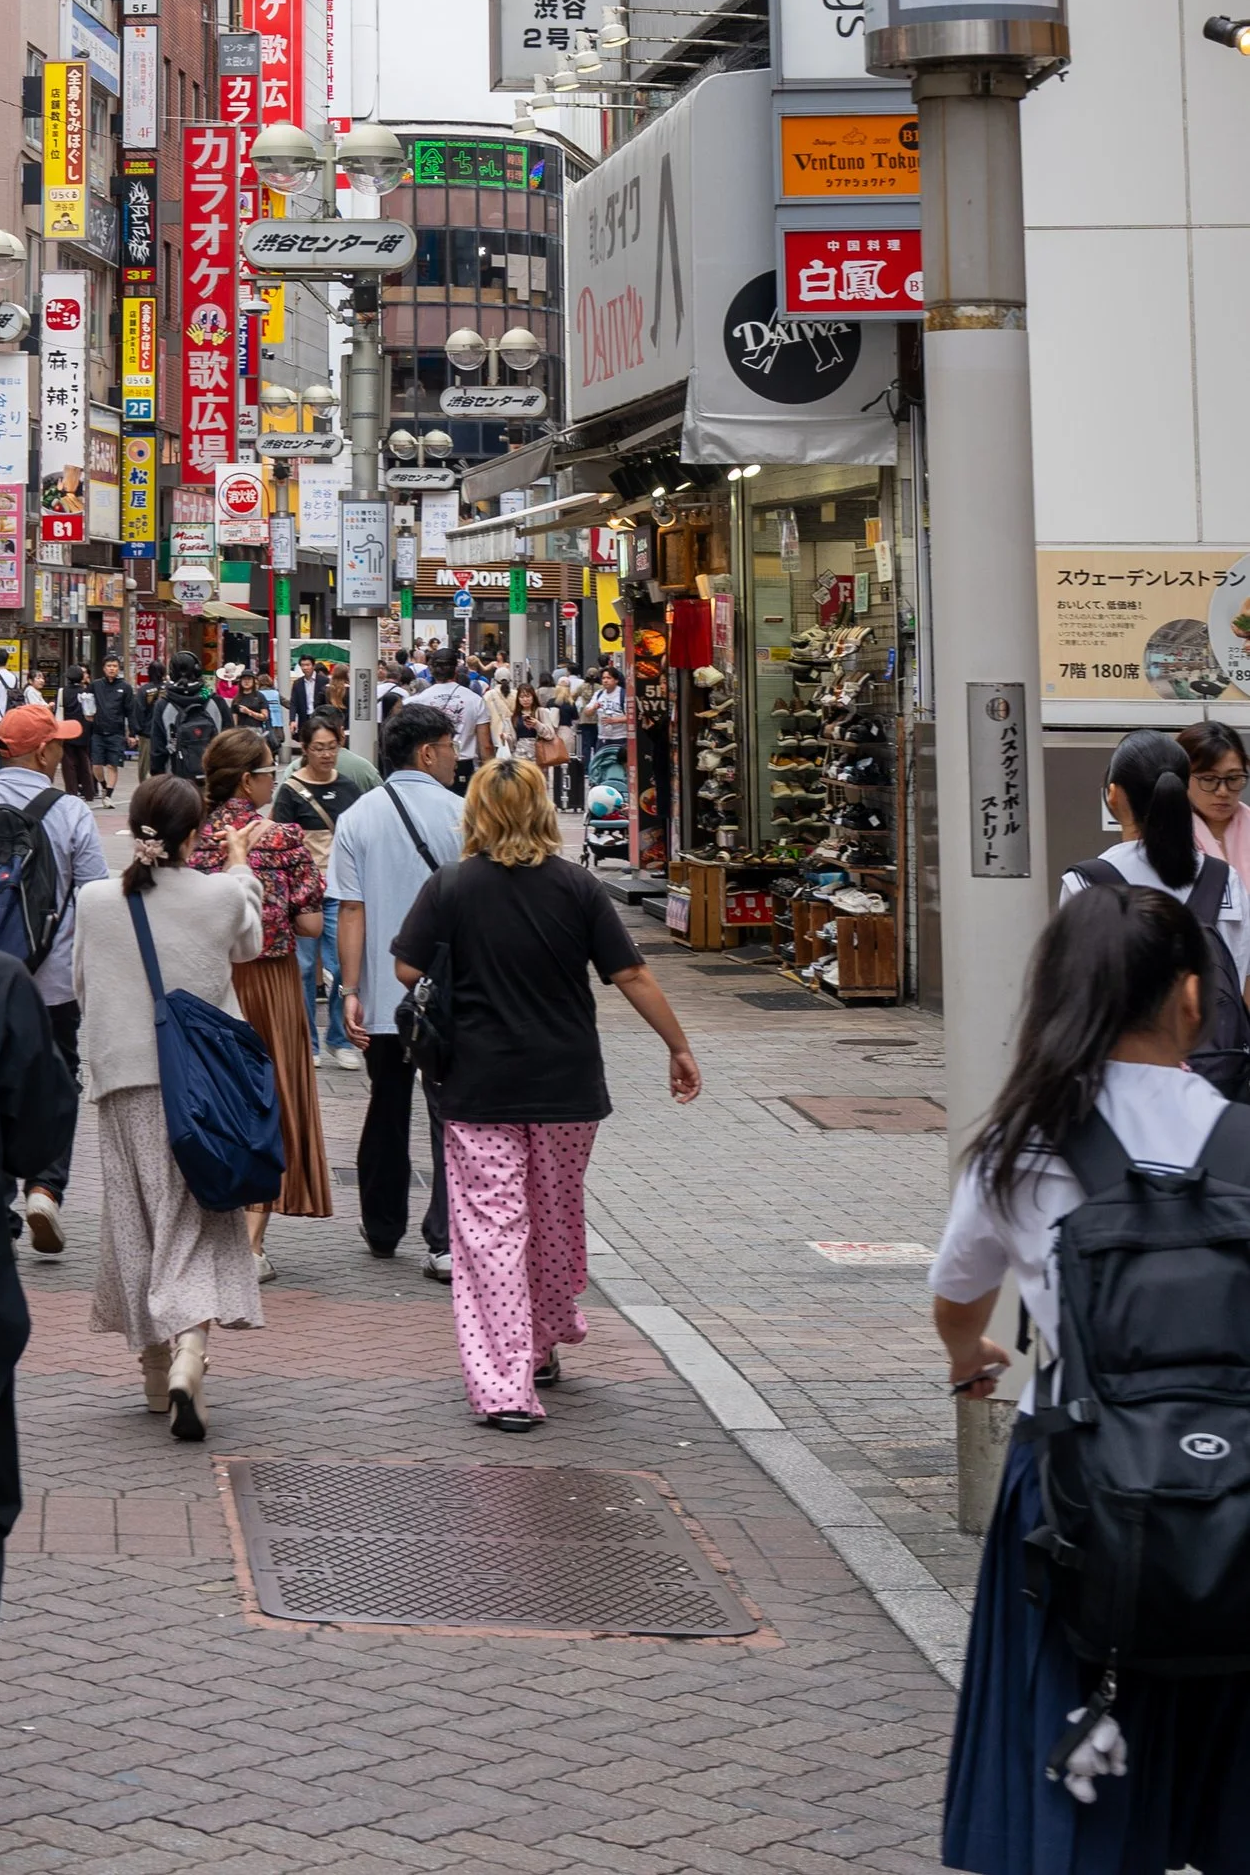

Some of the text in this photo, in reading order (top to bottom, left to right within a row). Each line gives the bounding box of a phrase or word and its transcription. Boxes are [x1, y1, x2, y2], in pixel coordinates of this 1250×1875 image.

[132, 4, 148, 13] 5F
[223, 43, 256, 53] センター街
[67, 68, 82, 181] 全身もみほぐし
[792, 153, 866, 172] Ventuno
[825, 178, 897, 188] シブヤショクドウ
[51, 191, 78, 200] りらくる
[189, 128, 230, 298] カラオケ
[253, 234, 405, 253] 渋谷センター街
[827, 239, 901, 252] 中国料理
[127, 270, 152, 280] 3F
[799, 260, 899, 302] 白鳳
[141, 304, 152, 370] 全身もみほぐし
[576, 285, 644, 388] DAIWA
[126, 376, 151, 385] りらくる
[47, 350, 69, 444] 麻辣湯
[447, 395, 540, 408] 渋谷センター街
[129, 402, 149, 416] 2F
[187, 350, 230, 475] 歌広場
[261, 439, 336, 450] 渋谷センター街
[390, 473, 450, 482] 渋谷センター街
[129, 467, 149, 509] 松屋
[227, 490, 257, 504] 消火栓
[52, 521, 73, 537] B1
[1057, 569, 1246, 588] スウェーデンレストラン
[1059, 663, 1140, 679] 7階 180席
[1000, 722, 1021, 836] バスケットボール
[981, 796, 999, 866] ストリート
